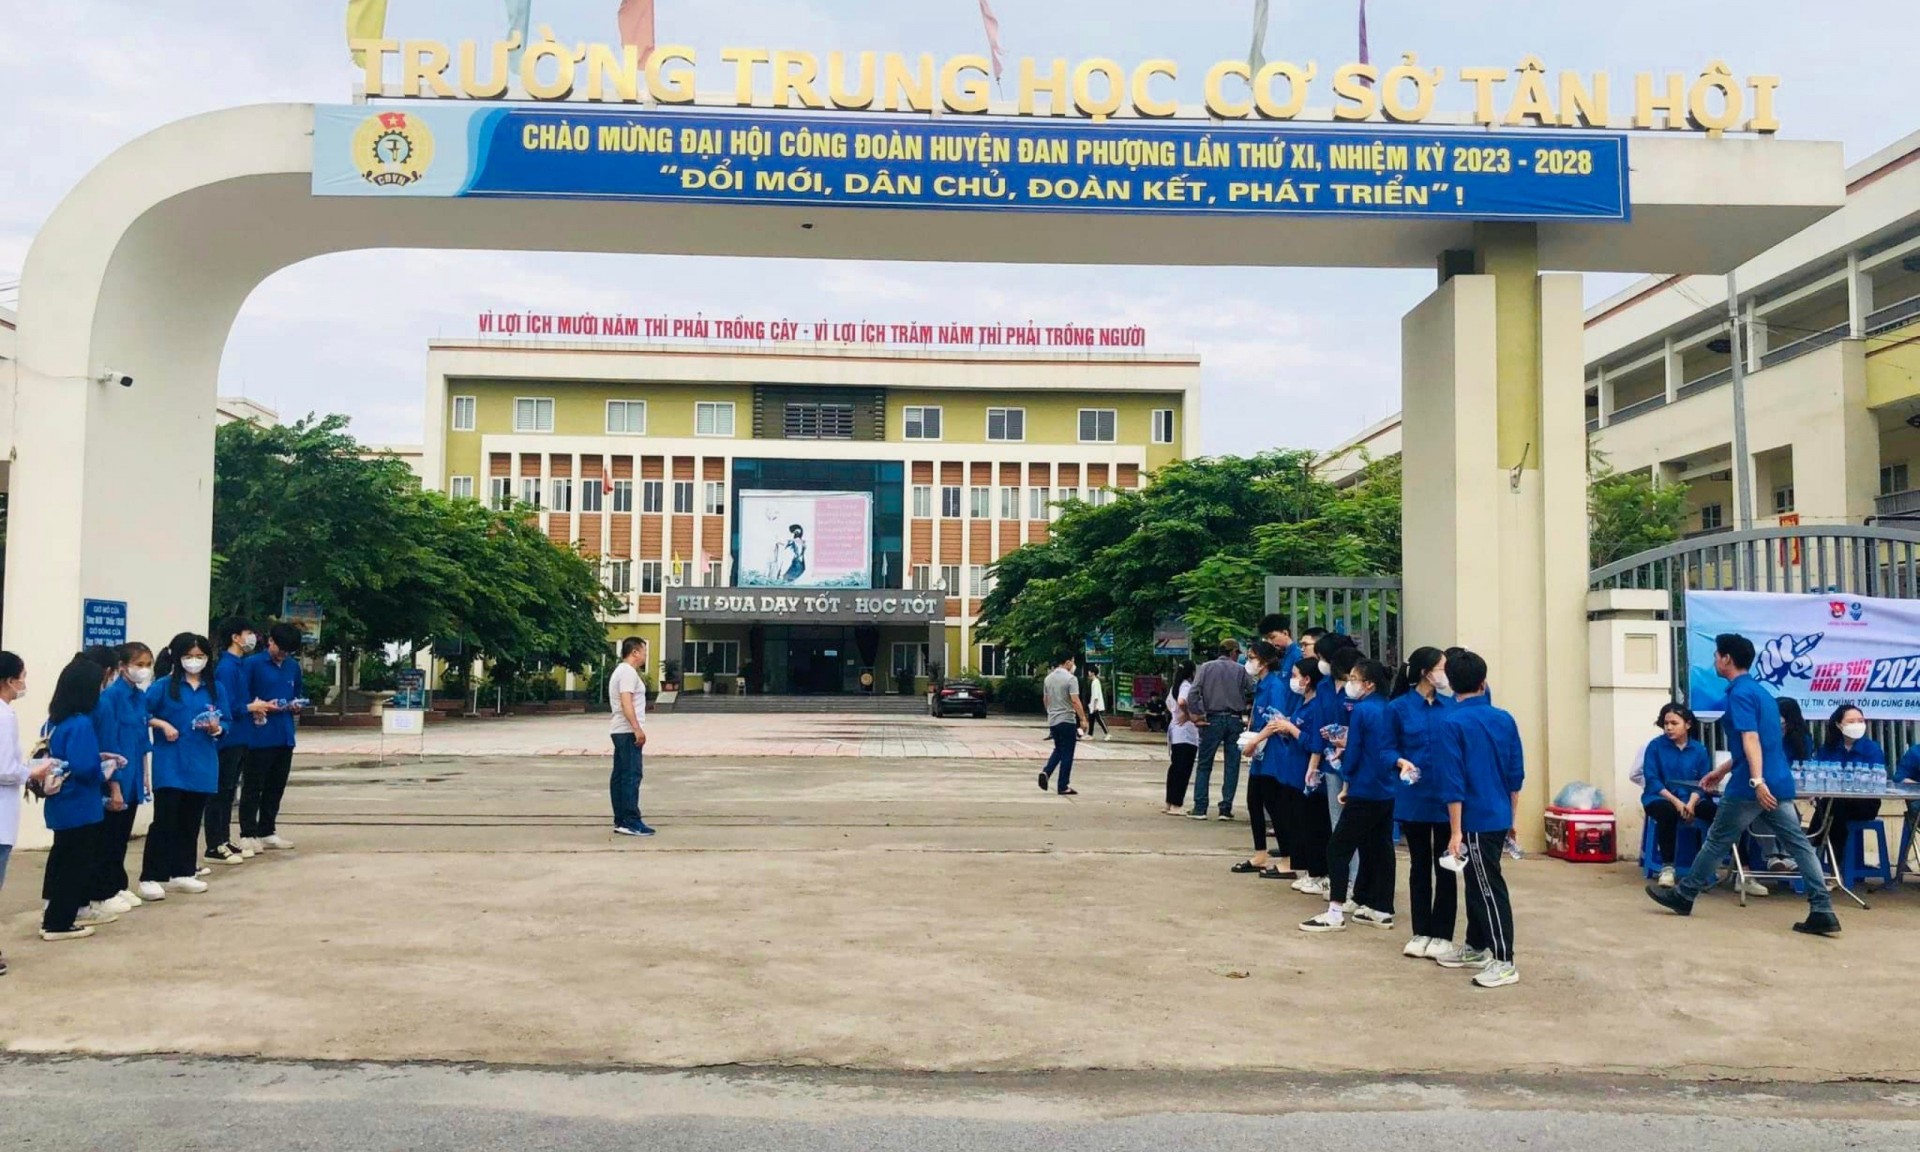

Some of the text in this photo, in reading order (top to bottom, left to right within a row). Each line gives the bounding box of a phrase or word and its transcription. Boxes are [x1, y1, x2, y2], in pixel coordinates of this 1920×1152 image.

[350, 24, 1781, 138] TRƯỜNG TRUNG HỌC CƠ SỞ TÂN HỘI
[523, 120, 590, 152] CHÀO
[598, 120, 673, 154] MỪNG
[680, 127, 722, 161] ĐẠI
[731, 125, 771, 162] HỘI
[780, 126, 847, 158] CÔNG
[855, 130, 922, 161] ĐOÀN
[931, 132, 1010, 168] HUYỆN
[1018, 138, 1068, 165] ĐAN
[1076, 137, 1176, 172] PHƯỢNG
[1184, 133, 1230, 168] LẦN
[1238, 135, 1286, 169] THỨ
[1291, 143, 1322, 173] XI,
[1329, 140, 1408, 175] NHIỆM
[1416, 141, 1446, 172] KỲ
[1453, 147, 1511, 173] 2023
[1535, 149, 1593, 175] 2028
[756, 165, 834, 196] MỚI,
[844, 170, 922, 195] DÂN
[933, 168, 1017, 201] CHỦ,
[1027, 173, 1131, 201] ĐOÀN
[1143, 172, 1217, 205] KẾT,
[1229, 178, 1324, 203] PHÁT
[479, 310, 493, 332] VÌ
[498, 312, 521, 337] LỢI
[527, 310, 552, 334] ÍCH
[557, 311, 598, 336] MƯỜI
[603, 313, 639, 337] NĂM
[645, 313, 668, 337] THÌ
[673, 311, 709, 338] PHẢI
[715, 314, 766, 340] TRỒNG
[770, 317, 799, 341] CÂY
[814, 318, 828, 342] VÌ
[833, 321, 856, 346] LỢI
[861, 319, 886, 343] ÍCH
[891, 320, 931, 344] TRĂM
[938, 321, 974, 345] NĂM
[979, 321, 1002, 346] THÌ
[1006, 319, 1041, 346] PHẢI
[1045, 321, 1095, 346] TRỒNG
[1100, 323, 1146, 347] NGƯỜI
[677, 594, 711, 612] THI
[714, 595, 756, 613] ĐUA
[760, 596, 800, 616] DẠY
[804, 590, 841, 614] TỐT
[855, 597, 897, 618] HỌC
[901, 591, 938, 615] TỐT
[1844, 677, 1867, 692] THI
[1871, 657, 1920, 688] 202
[1858, 697, 1870, 707] TÔI
